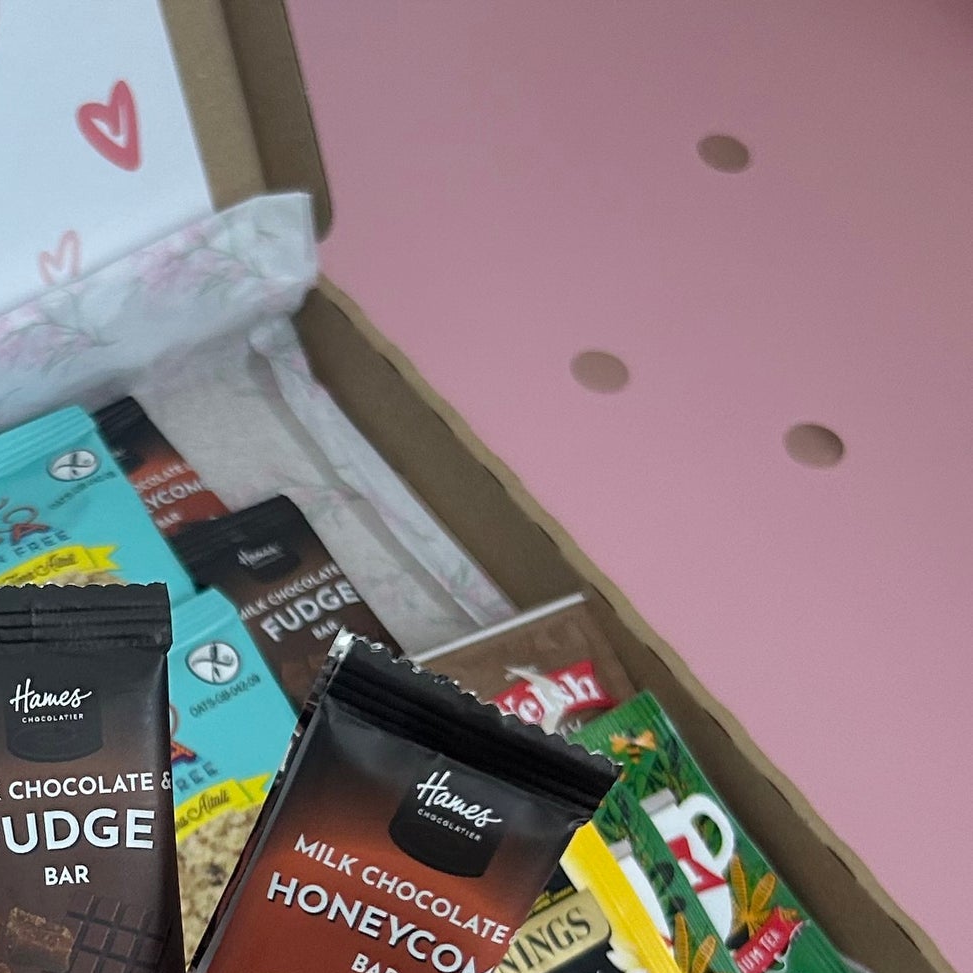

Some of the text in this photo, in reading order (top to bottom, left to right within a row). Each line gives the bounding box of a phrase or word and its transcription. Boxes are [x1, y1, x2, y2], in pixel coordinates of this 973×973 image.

[13, 529, 72, 558] FREE
[260, 581, 362, 642] FUDGE
[9, 678, 93, 714] Hames
[21, 713, 85, 724] CHOCOLATIER
[8, 772, 154, 800] CHOCOLATE
[160, 771, 172, 790] &
[175, 760, 220, 794] REE
[416, 770, 503, 828] Hames
[417, 807, 483, 843] CHOCOLATIER
[44, 864, 90, 886] BAR
[293, 833, 359, 877] MILK
[361, 865, 510, 946] CHOCOLATE
